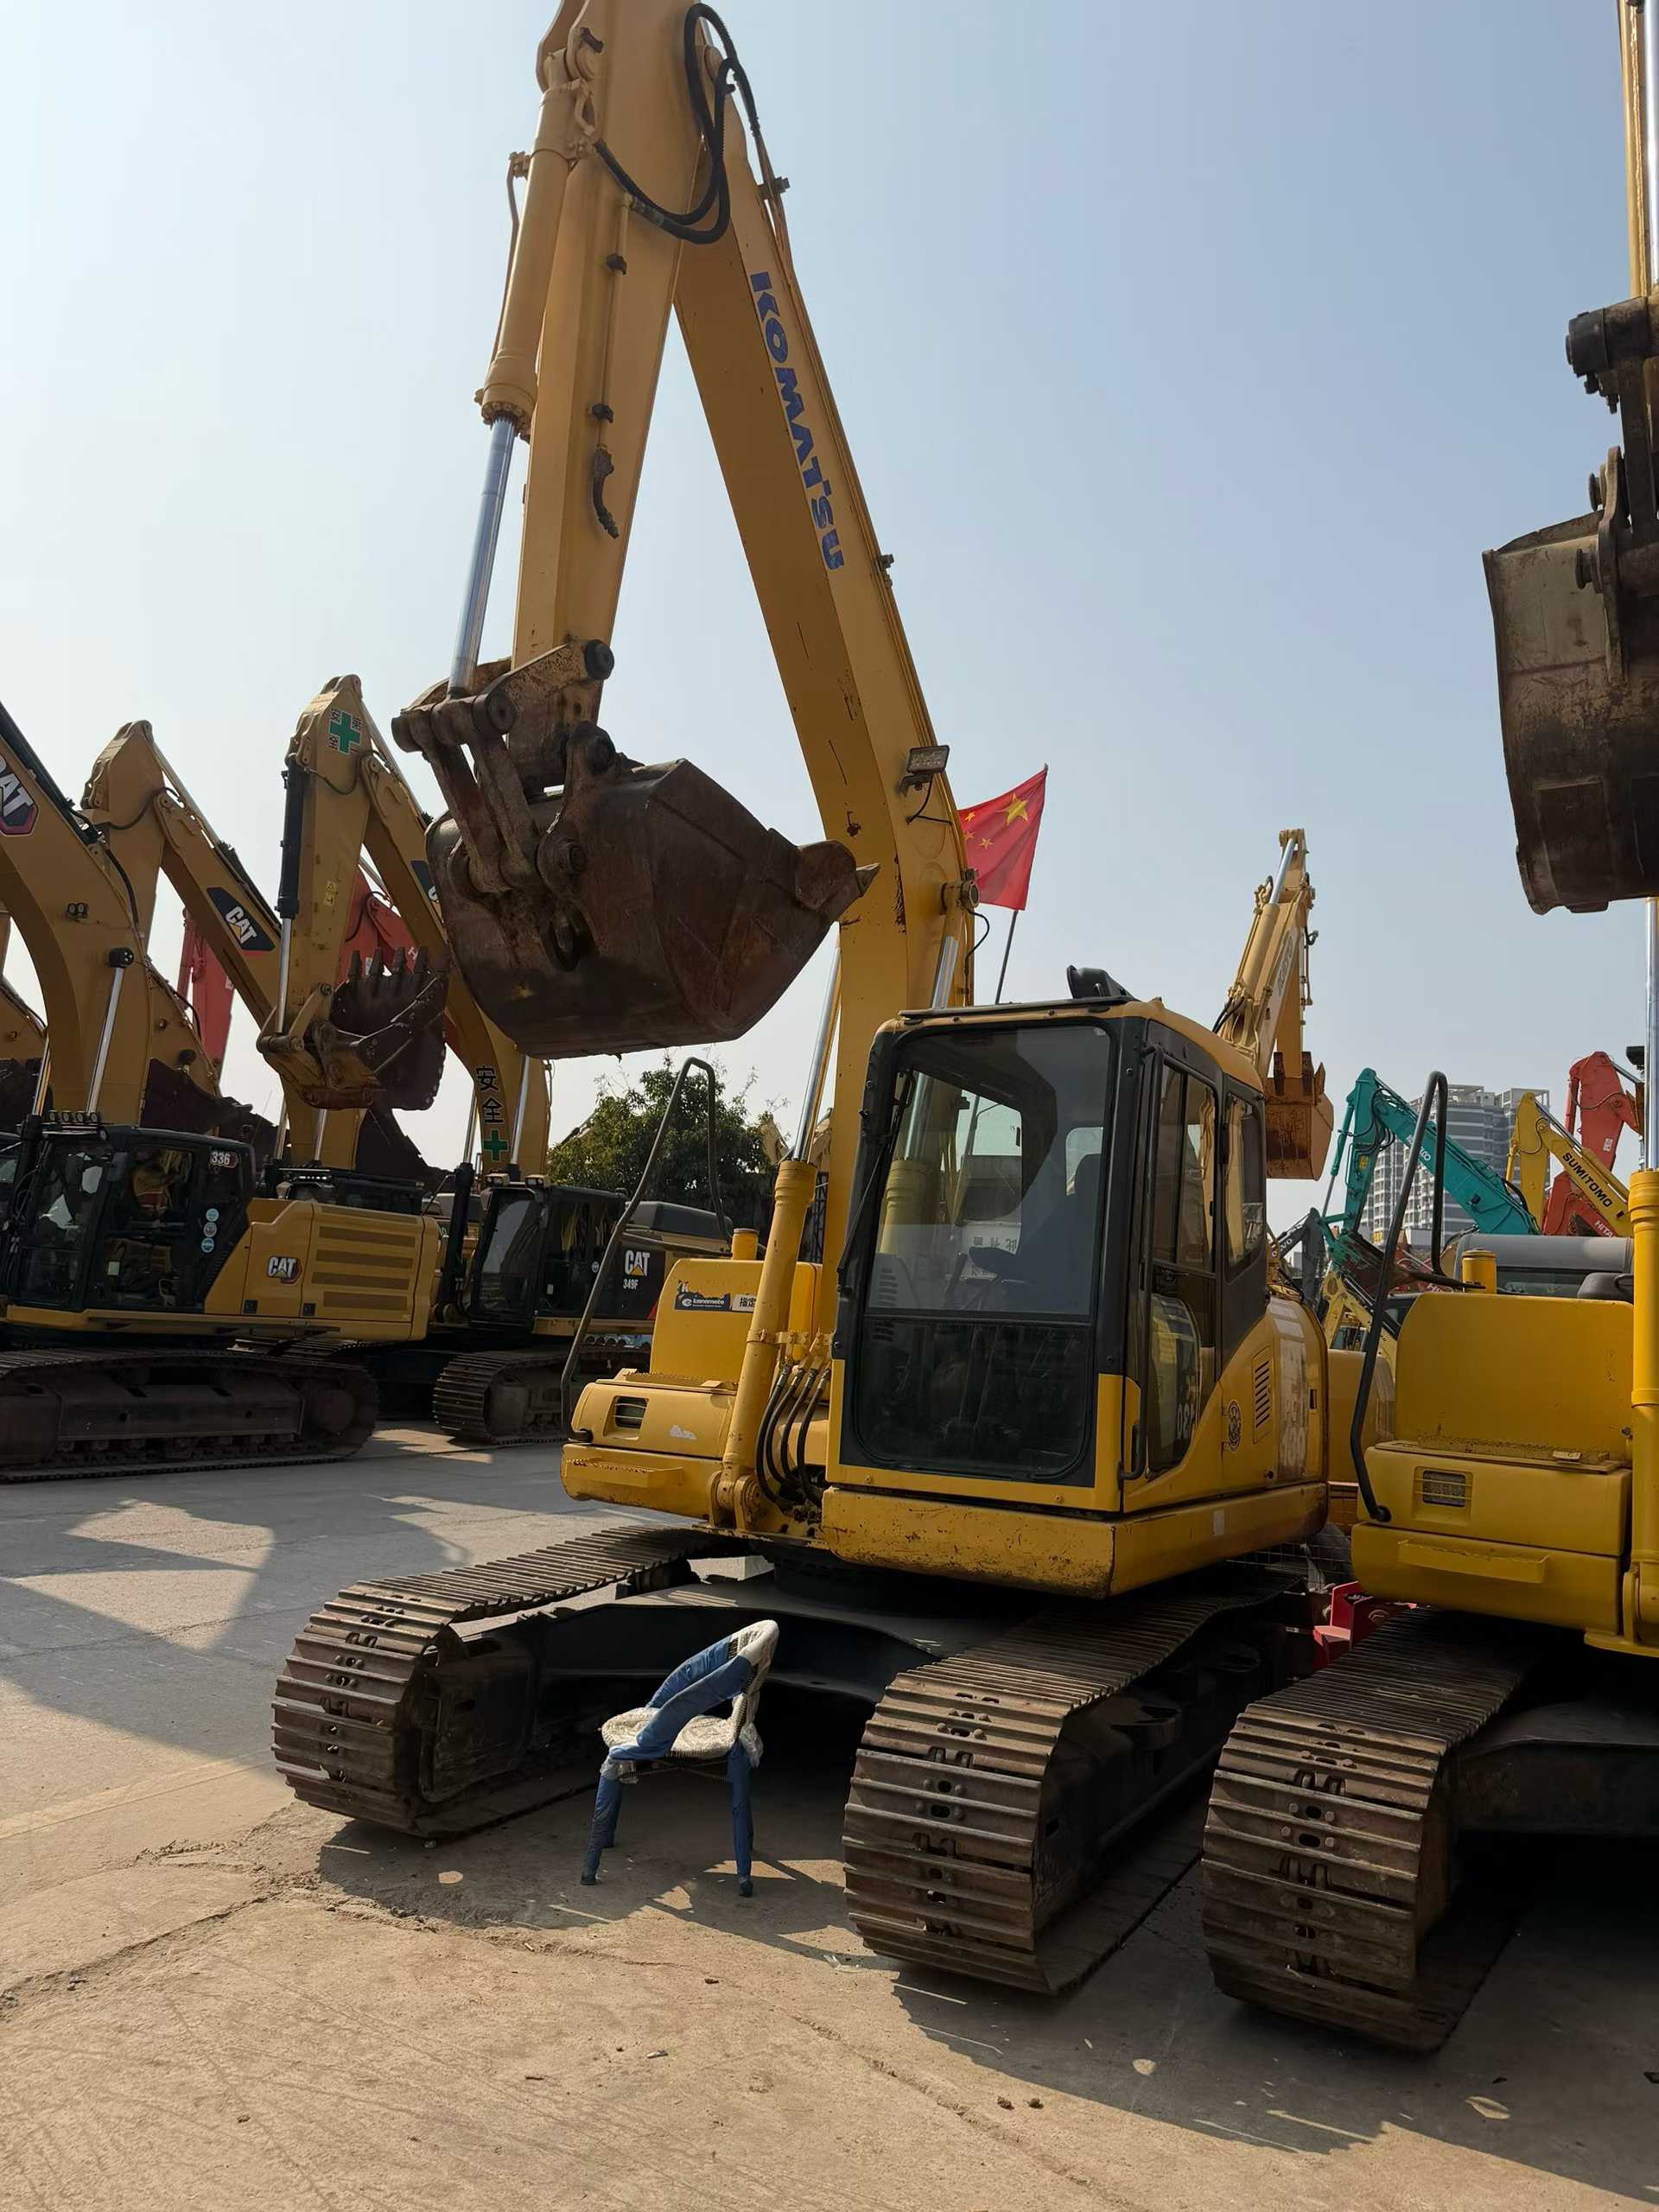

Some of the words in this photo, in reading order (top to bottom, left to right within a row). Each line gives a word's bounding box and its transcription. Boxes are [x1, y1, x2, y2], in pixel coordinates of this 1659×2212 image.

[750, 271, 845, 571] KOMATSU
[226, 906, 257, 945] CAT
[476, 1065, 505, 1123] 安全
[1562, 1152, 1612, 1208] SUMITOMO
[1594, 1220, 1614, 1237] HITA
[269, 1256, 296, 1279] CAT
[625, 1249, 651, 1276] CAT
[623, 1278, 639, 1290] 349F
